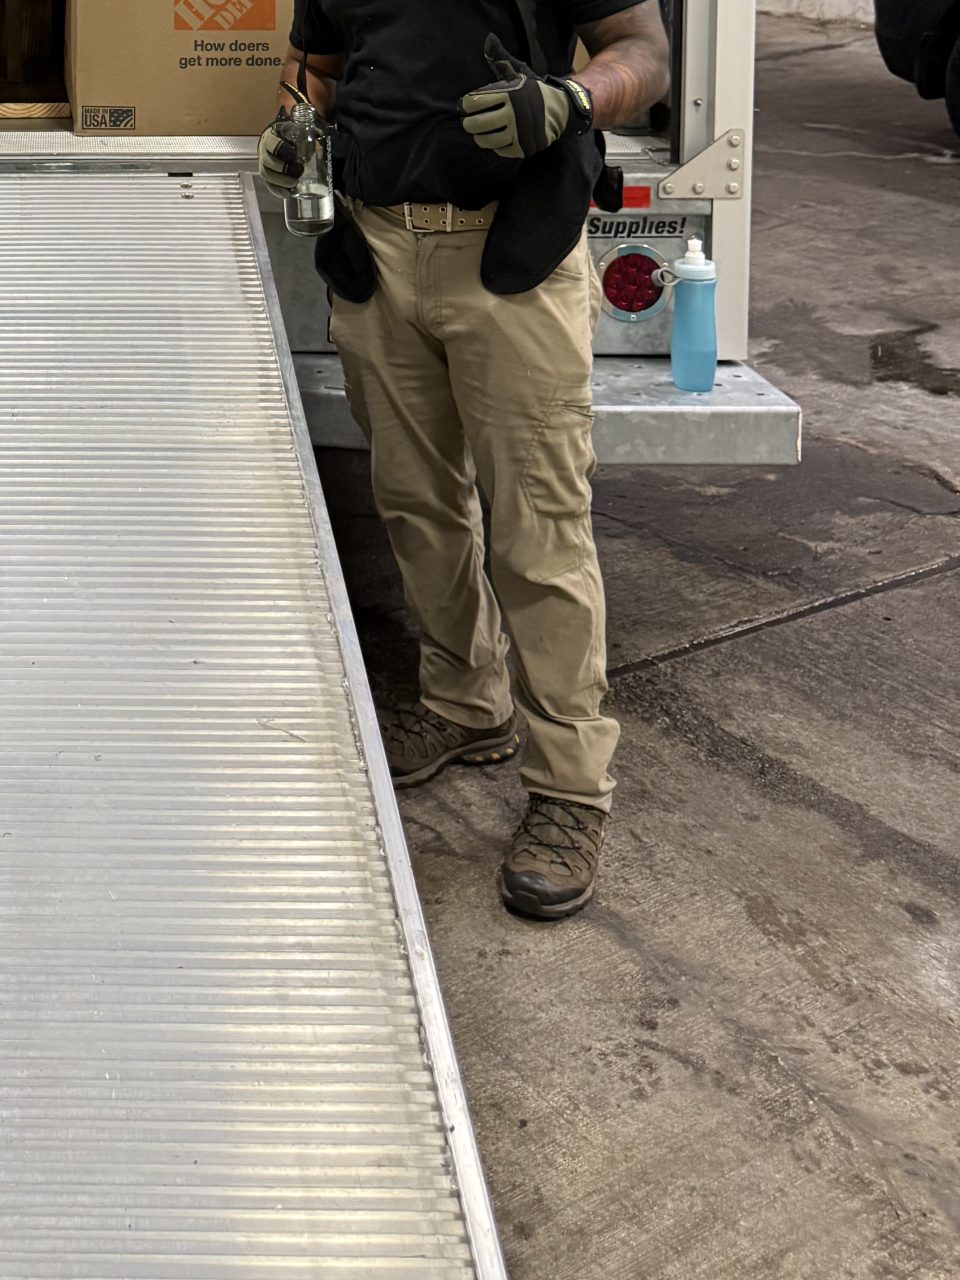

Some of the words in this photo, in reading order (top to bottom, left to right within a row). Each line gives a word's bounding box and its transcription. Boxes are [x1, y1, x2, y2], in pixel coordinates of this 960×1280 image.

[194, 40, 225, 52] How
[229, 40, 270, 52] doers
[179, 55, 202, 69] get
[205, 56, 241, 67] more
[245, 53, 284, 67] done.
[84, 114, 108, 128] USA
[588, 216, 687, 238] Supplies!
